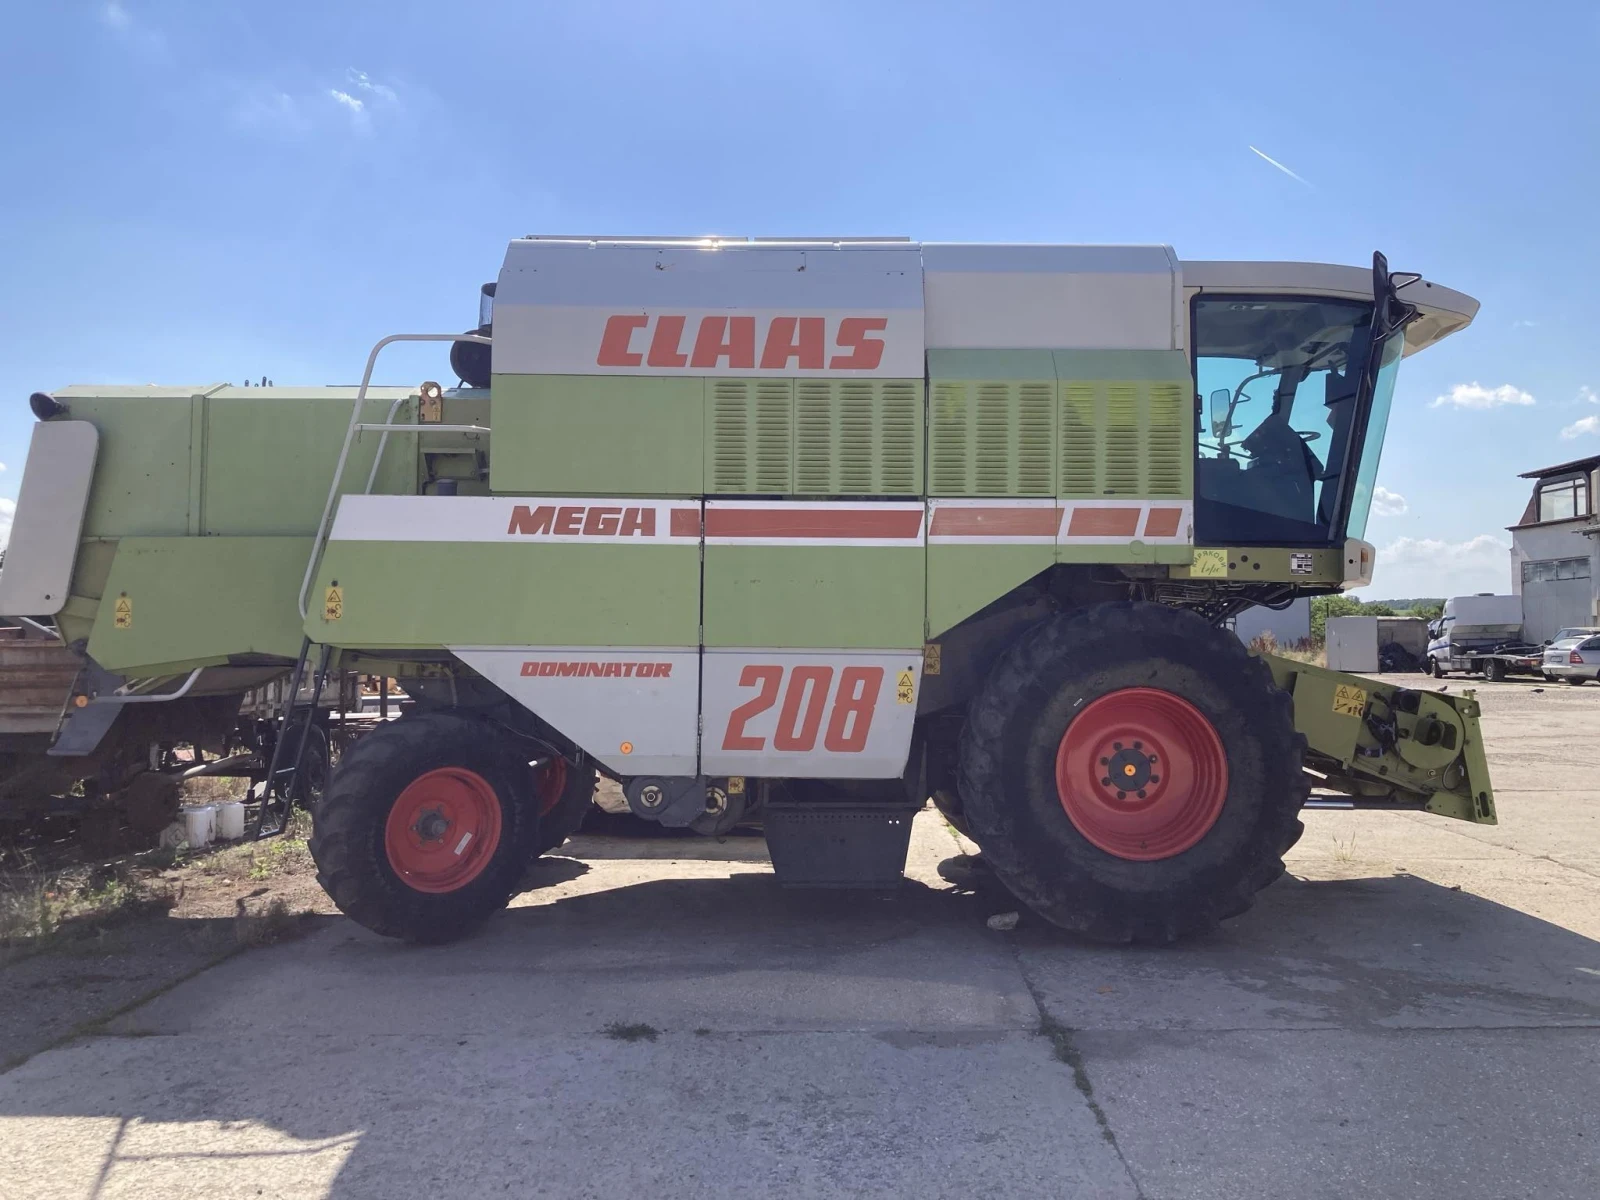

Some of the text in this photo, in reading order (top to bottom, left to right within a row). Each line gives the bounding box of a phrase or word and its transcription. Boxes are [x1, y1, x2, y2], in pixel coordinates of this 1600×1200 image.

[597, 315, 888, 370] CLAAS
[508, 506, 656, 536] MEGA
[520, 661, 673, 678] DOMINATOR
[721, 664, 885, 753] 208
